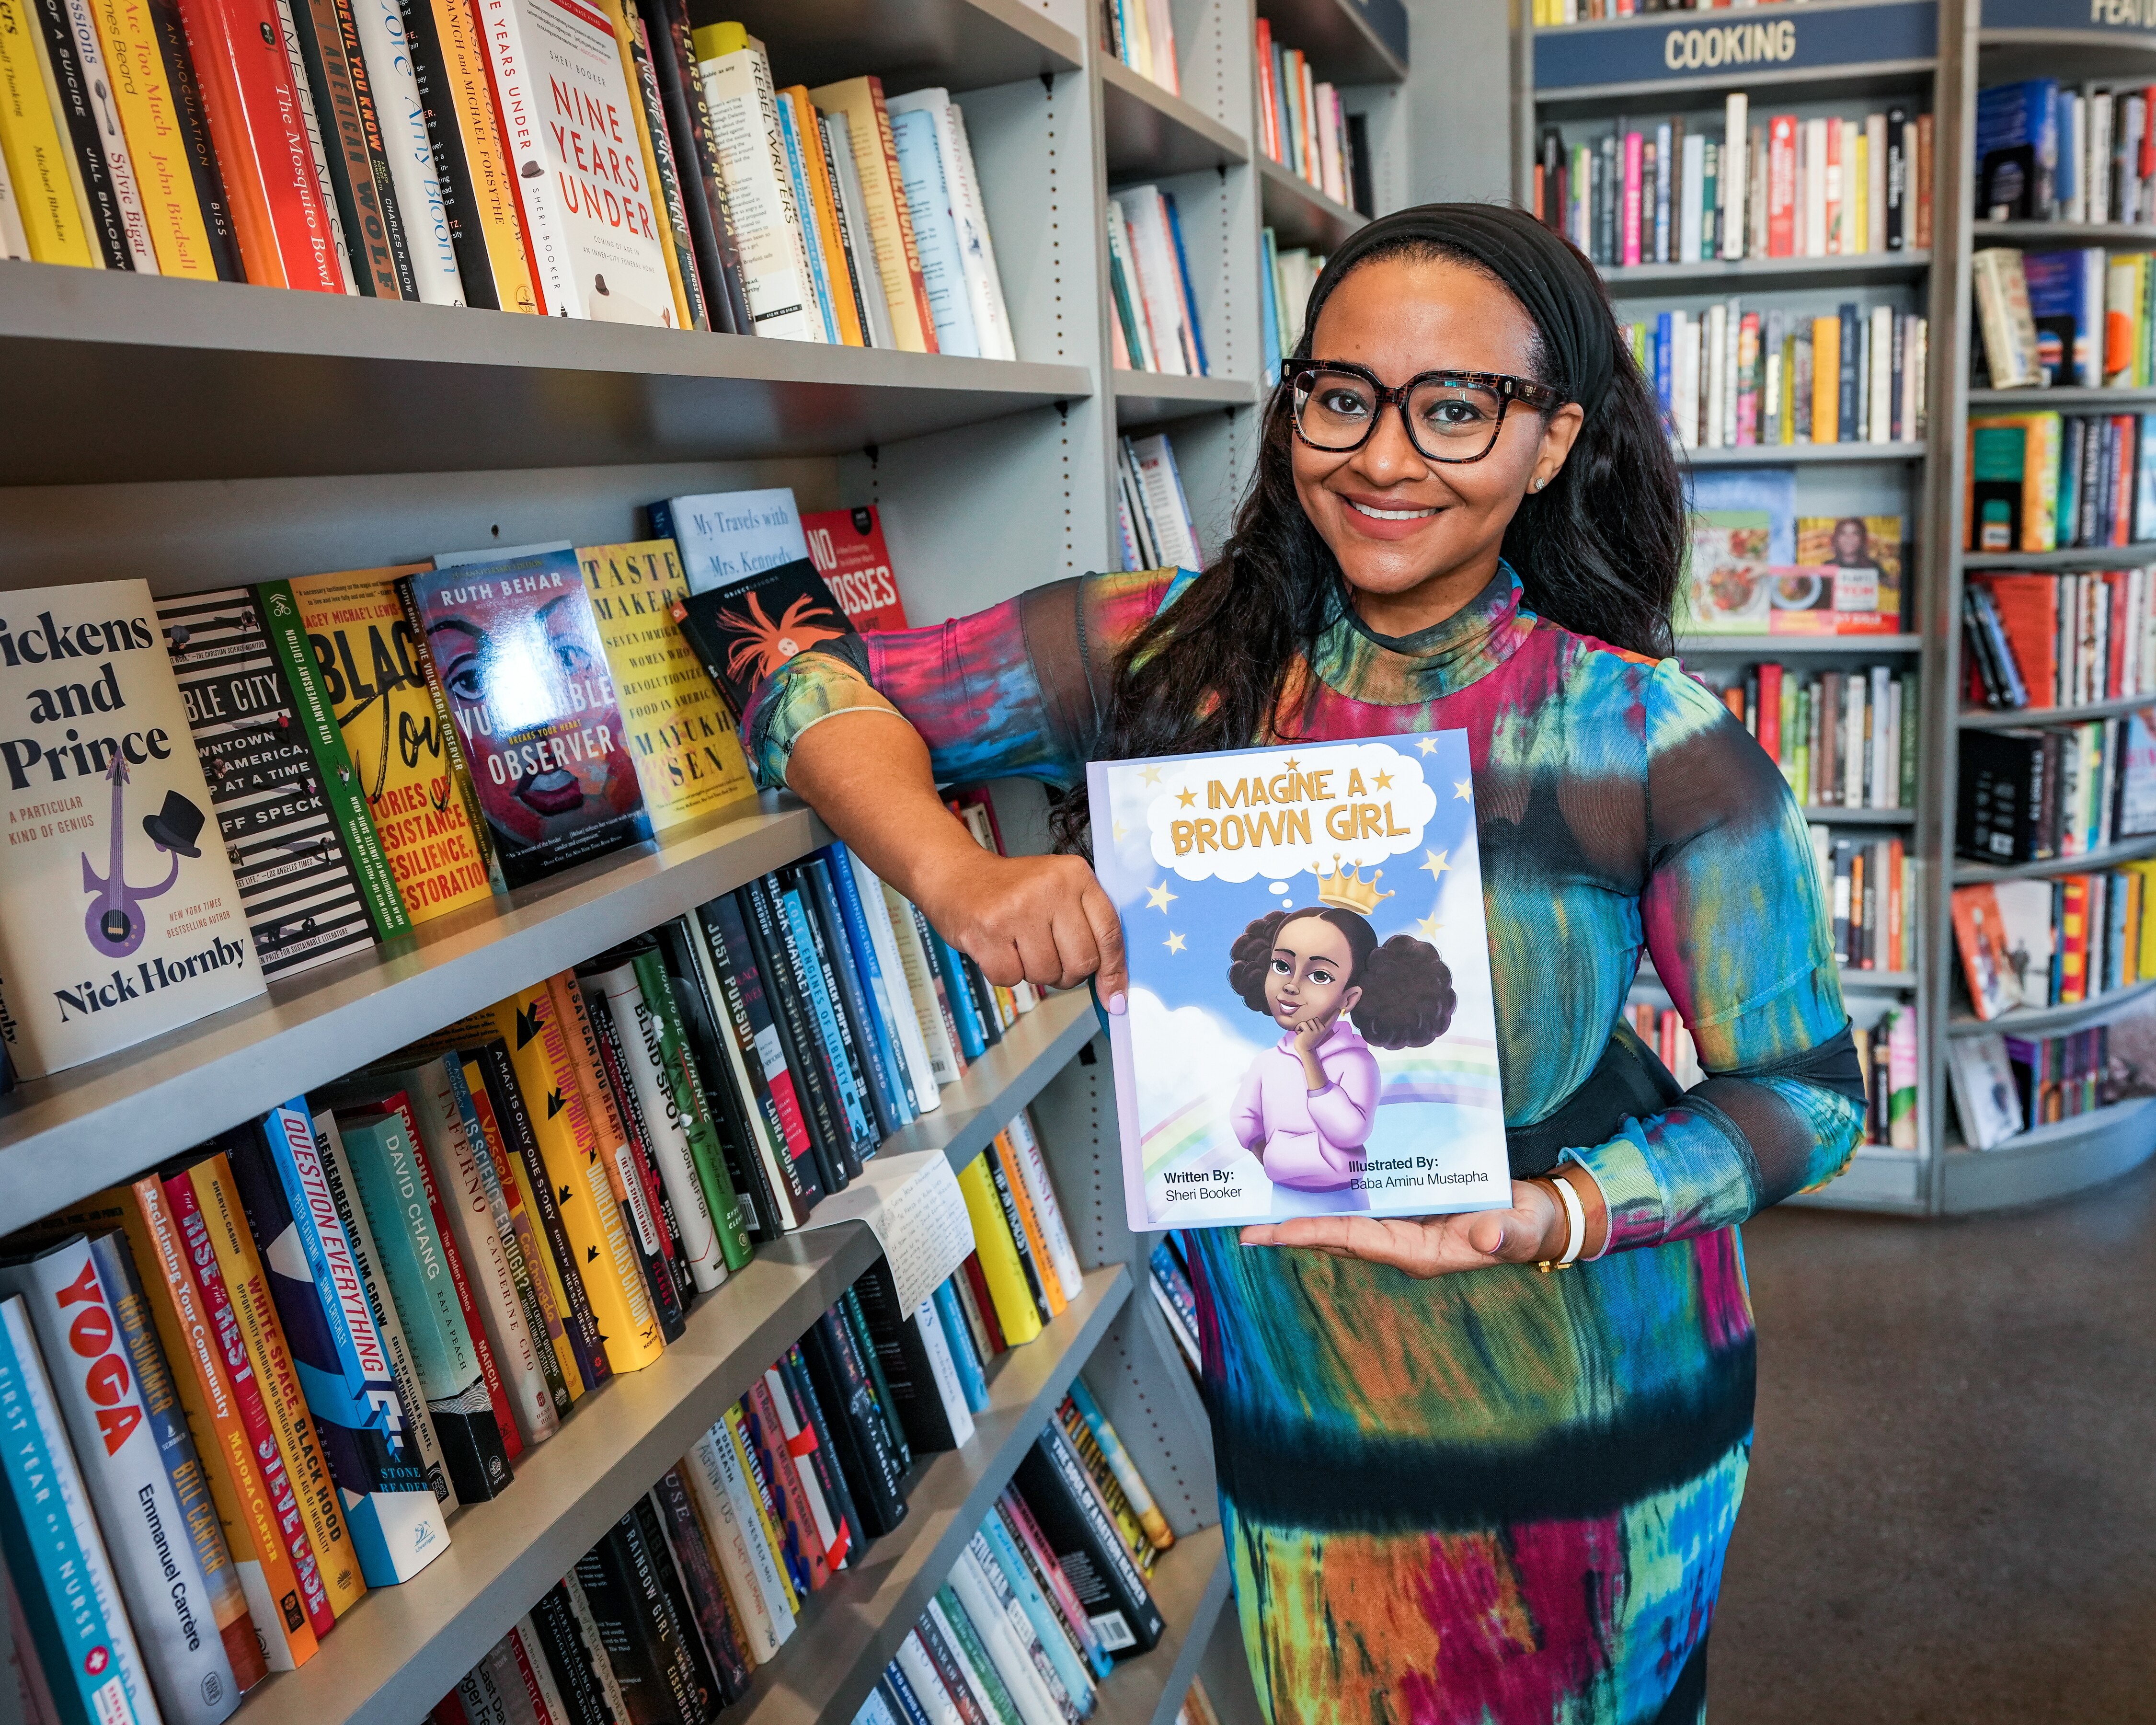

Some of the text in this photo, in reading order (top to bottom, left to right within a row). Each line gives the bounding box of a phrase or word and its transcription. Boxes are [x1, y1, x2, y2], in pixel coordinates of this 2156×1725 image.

[493, 18, 515, 77] YEARS
[550, 50, 606, 87] SHERI BOOKER
[1664, 20, 1796, 69] COOKING
[60, 48, 86, 117] SUICIDE
[134, 40, 172, 137] Too Much
[170, 53, 209, 166] INOCULATION
[325, 46, 363, 163] AMERICAN
[350, 56, 382, 151] YOU KNOW
[550, 72, 623, 144] NINE
[463, 80, 505, 225] MICHAEL FORSYTHE
[509, 87, 530, 150] UNDER
[681, 23, 734, 237] TEARS OVER RUSSIA
[751, 60, 794, 225] REBEL WRITERS
[275, 84, 334, 287] The Mosquito Bowl
[405, 96, 456, 274] Amy Bloom
[551, 121, 640, 192] YEARS
[86, 148, 126, 270] JILL BIALOSKY
[107, 152, 147, 256] Sylvie Bigar
[149, 151, 197, 271] John Birdsall
[211, 203, 227, 235] BISS
[532, 187, 561, 289] SHERI BOOKER
[559, 172, 654, 241] UNDER
[385, 198, 402, 247] CHARLES
[400, 263, 412, 292] BLOW
[583, 246, 655, 274] AN INNER-CITY FUNERAL HOME
[594, 236, 615, 250] COMING
[616, 243, 623, 251] OF
[623, 245, 633, 254] AGE
[686, 252, 704, 318] JOHN ROSS BOWIE
[715, 506, 789, 534] Travels with
[811, 529, 837, 571] NO
[440, 583, 493, 607] RUTH
[500, 573, 563, 598] BEHAR
[582, 551, 681, 591] TASTE
[709, 555, 737, 578] Mrs.
[401, 584, 419, 635] RUTH BEHAR
[593, 586, 690, 621] MAKERS
[0, 611, 153, 666] ickens
[205, 647, 226, 657] CHRISTIAN
[227, 644, 244, 655] SCIENCE
[245, 641, 265, 651] MONITOR
[26, 662, 126, 724] and
[230, 673, 281, 712] CITY
[285, 630, 333, 746] EDITION ANNIVERSARY 10TH
[417, 643, 463, 770] THE VULNERABLE OBSERVER
[0, 727, 171, 790] Prince
[223, 747, 310, 772] AMERICA,
[487, 725, 615, 784] OBSERVER
[635, 710, 731, 758] MAYUKH
[667, 744, 725, 788] SEN
[9, 796, 83, 824] A PARTICULAR
[226, 762, 310, 792] AT A TIME
[257, 796, 324, 823] SPECK
[1206, 769, 1367, 809] IMAGINE A
[9, 815, 94, 845] KIND OF GENIUS
[1170, 801, 1411, 857] BROWN GIRL
[276, 863, 297, 875] ANGELES
[298, 858, 313, 872] TIMES
[167, 910, 231, 938] BESTSELLING AUTHOR
[169, 898, 222, 921] NEW YORK TIMES
[54, 936, 244, 1024] Nick Hornby
[708, 923, 757, 1051] JUST PURSUIT
[634, 1004, 684, 1133] BLIND SPOT
[501, 1063, 555, 1220] MAP IS ONLY ONE STORY
[566, 1093, 596, 1155] PRIVACY
[764, 1098, 803, 1197] LAURA COATES
[680, 1146, 709, 1219] JON CLIFTON
[1164, 1170, 1235, 1184] Written By:
[1165, 1185, 1242, 1201] Sheri Booker
[1349, 1156, 1439, 1173] Illustrated By:
[1350, 1171, 1489, 1191] Baba Aminu Mustapha
[212, 1180, 241, 1255] SHERYLL CASHIN
[317, 1133, 388, 1327] REMEMBERING JIM CROW
[386, 1135, 440, 1280] DAVID CHANG
[437, 1089, 534, 1371] INFERNO CATHERINE CHO
[463, 1118, 530, 1288] IS SCIENCE ENOUGH?
[283, 1117, 384, 1373] QUESTION EVERYTHING
[145, 1188, 229, 1420] Reclaiming Your Community
[182, 1211, 255, 1384] RISE REST
[329, 1304, 347, 1348] CRITCHLEY
[437, 1290, 449, 1313] EAT
[450, 1329, 467, 1372] PEACH
[575, 1310, 592, 1348] DEMARY
[56, 1258, 142, 1457] YOGA
[248, 1275, 342, 1543] WHITE SPACE, BLACK HOOD
[228, 1430, 277, 1563] MAJORA CARTER
[381, 1467, 420, 1479] STONE
[172, 1460, 226, 1576] BILL CARTER
[258, 1435, 327, 1614] STEVE CASE
[138, 1484, 200, 1653] Emmanuel Carrère
[626, 1526, 670, 1643] RAINBOW GIRL
